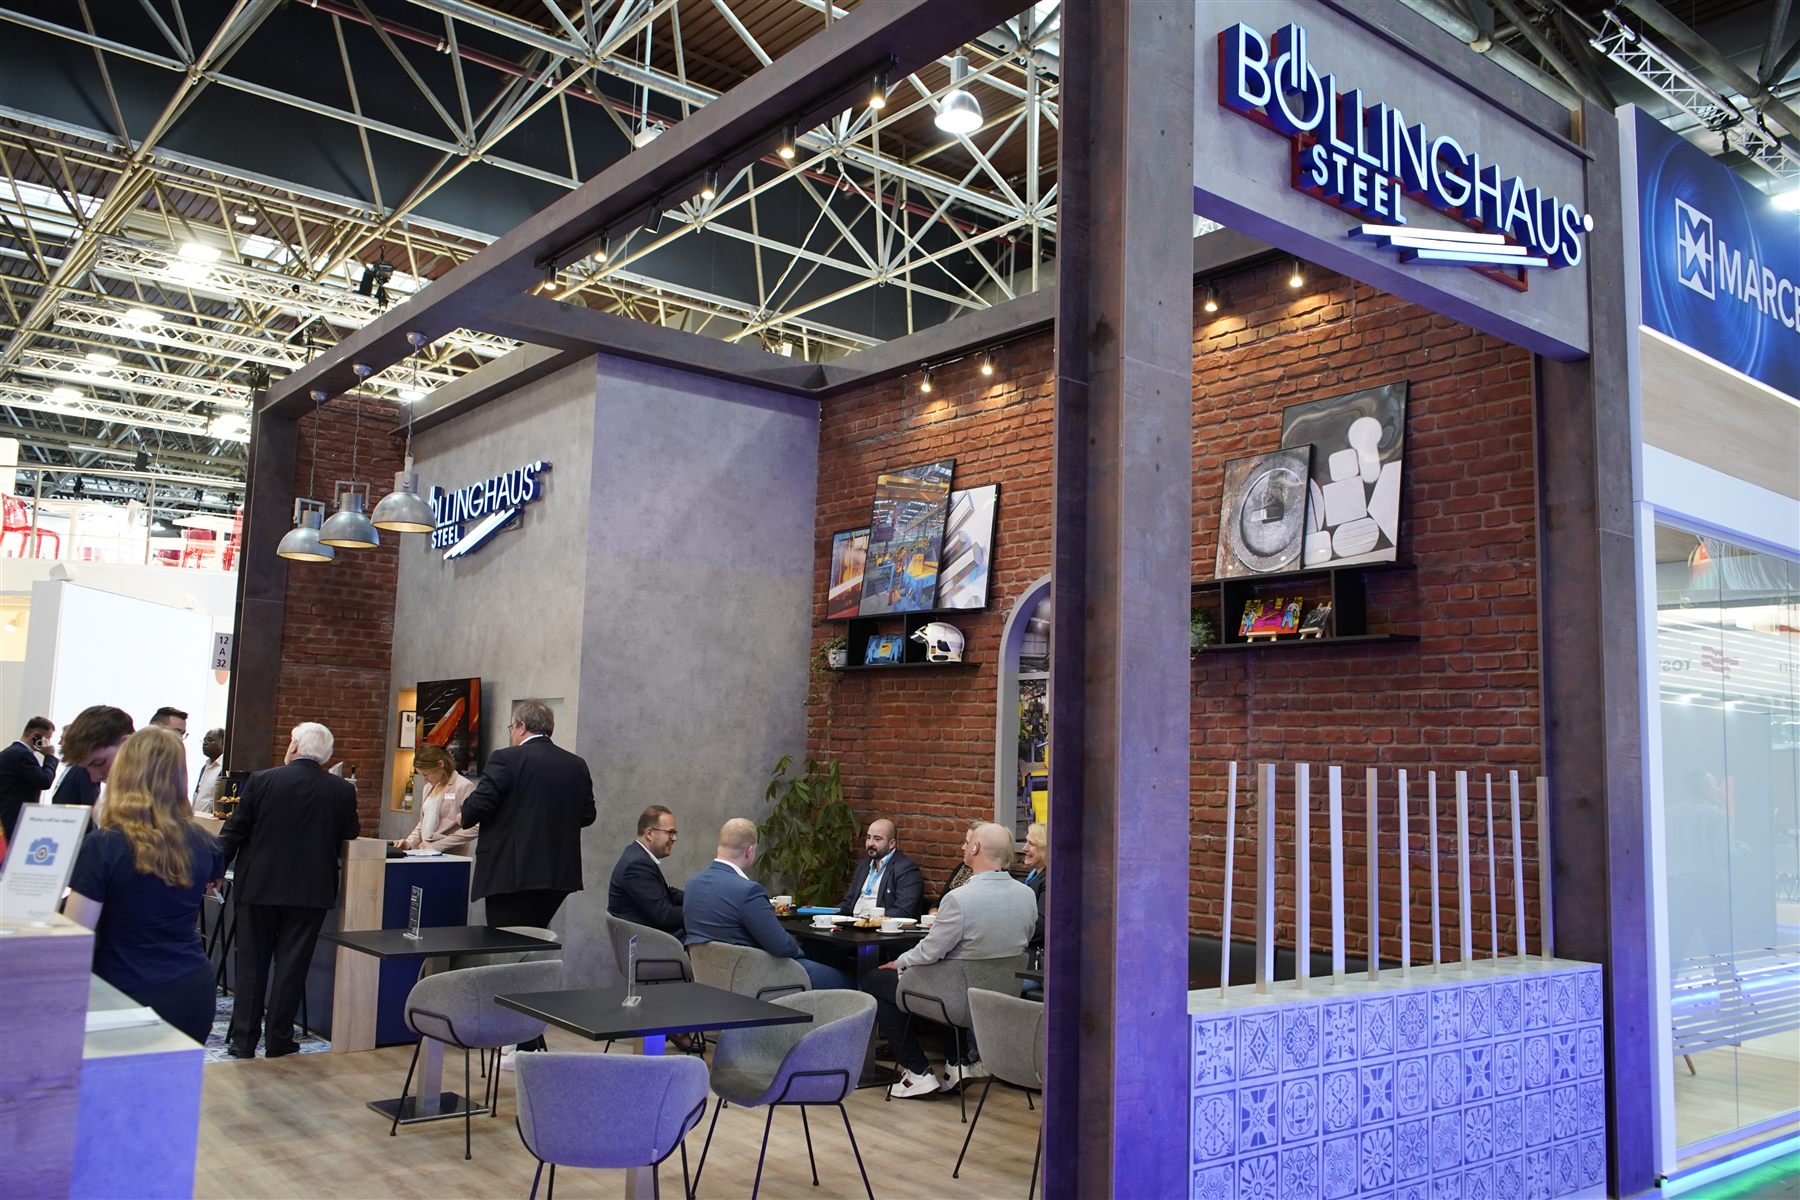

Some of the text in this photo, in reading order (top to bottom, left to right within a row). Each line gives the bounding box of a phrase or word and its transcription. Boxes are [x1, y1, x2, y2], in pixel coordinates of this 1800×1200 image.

[1311, 143, 1407, 224] STEEL
[431, 524, 459, 549] STEEL
[219, 636, 229, 644] 12
[216, 659, 226, 667] 32
